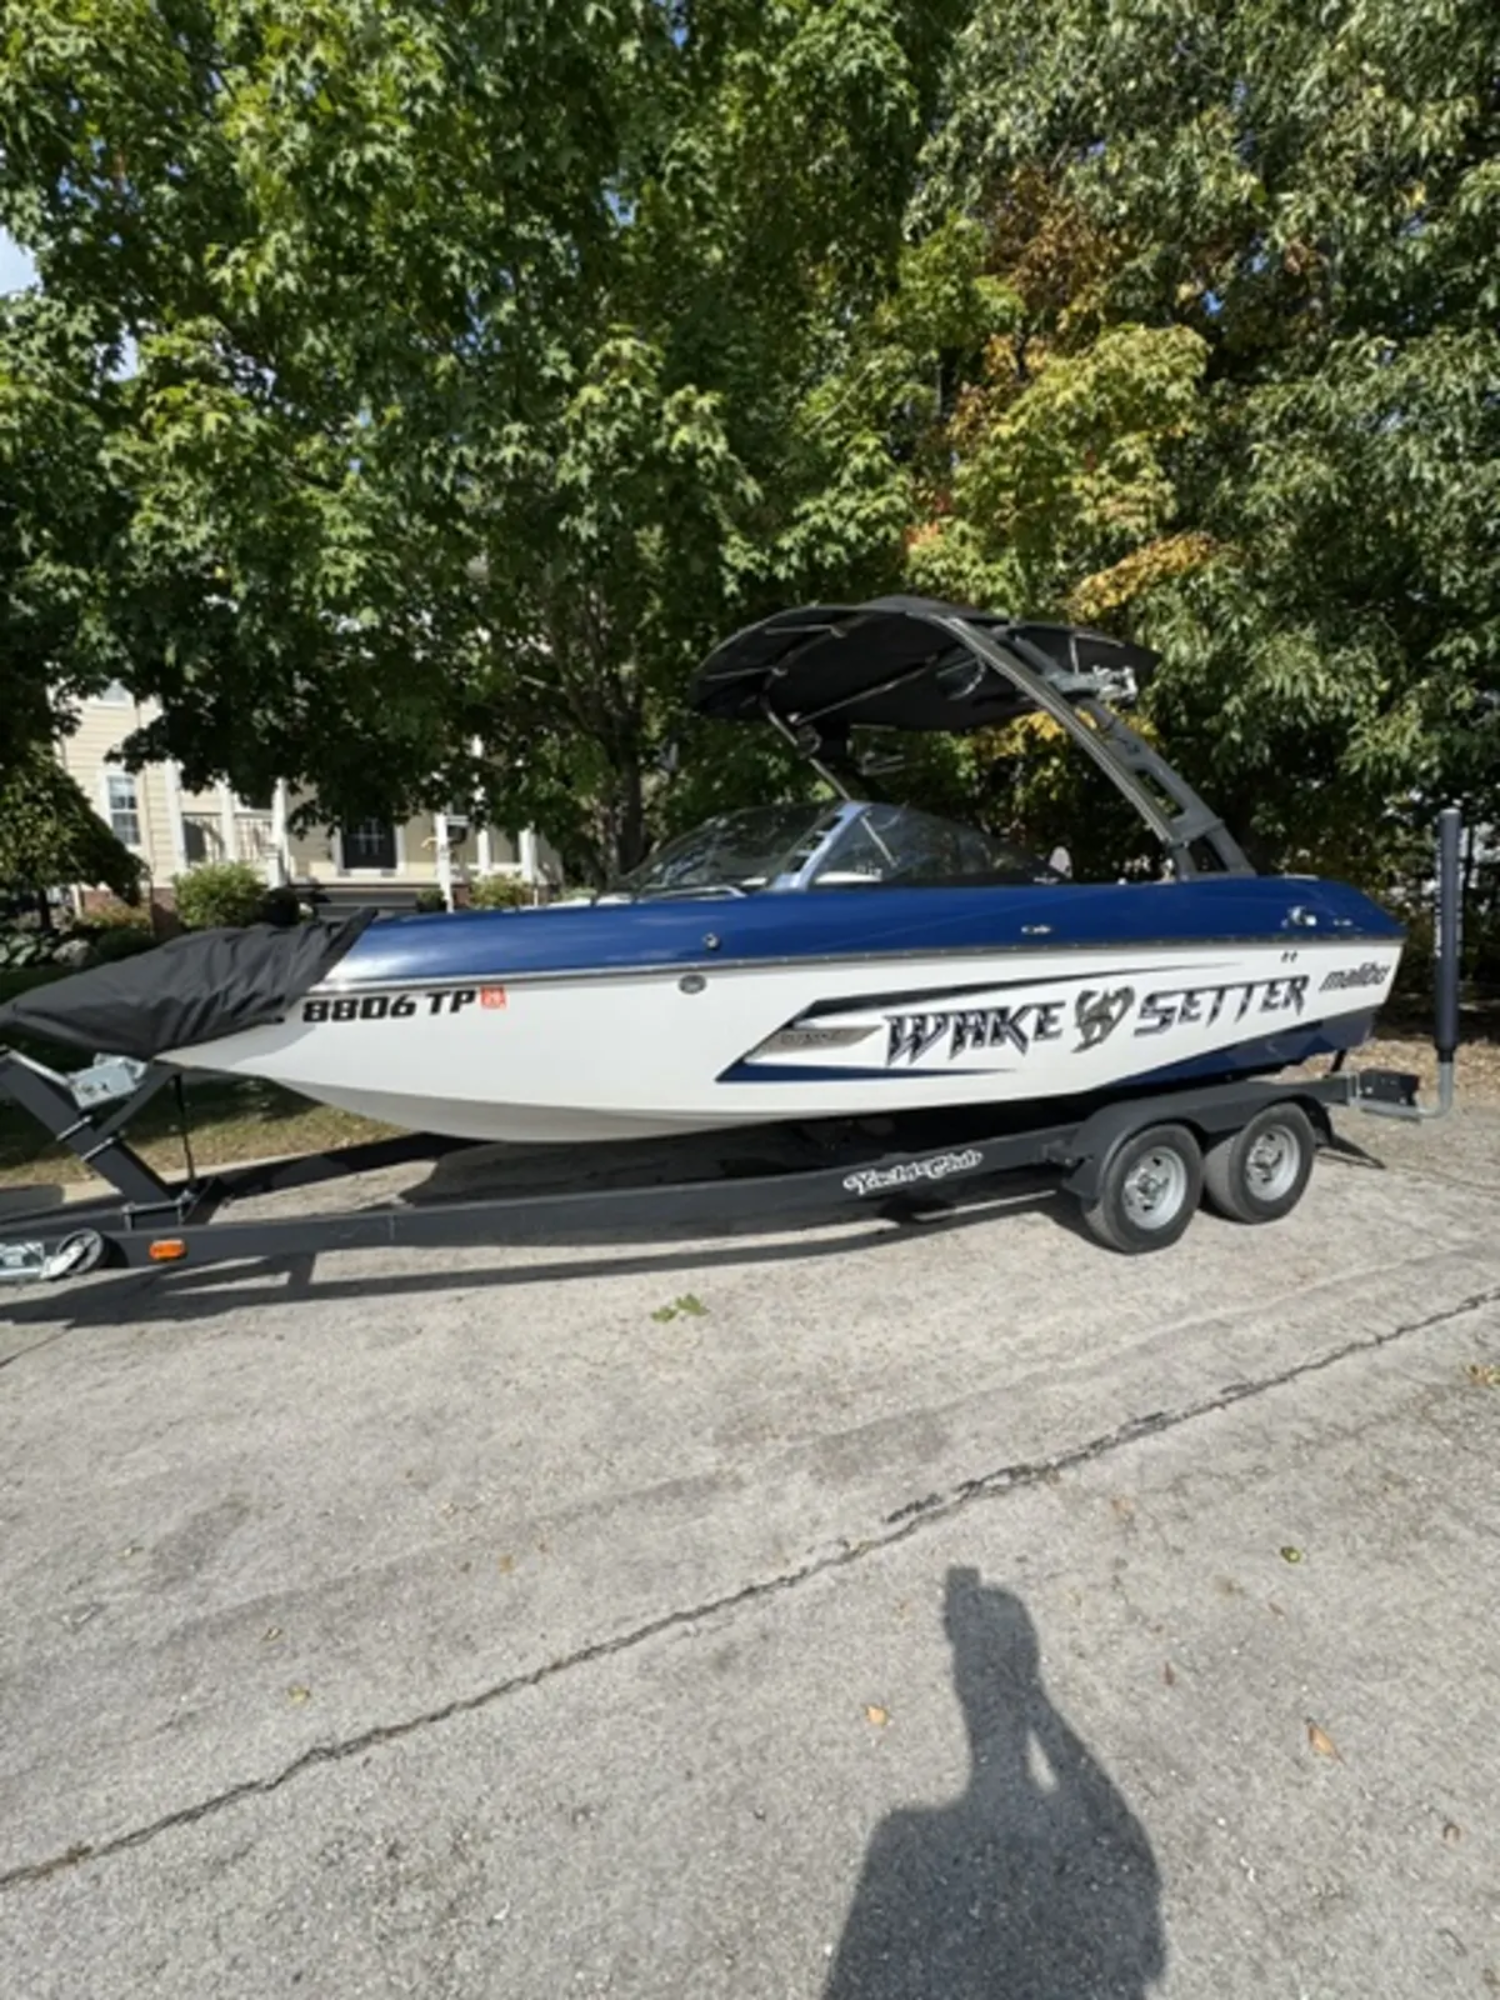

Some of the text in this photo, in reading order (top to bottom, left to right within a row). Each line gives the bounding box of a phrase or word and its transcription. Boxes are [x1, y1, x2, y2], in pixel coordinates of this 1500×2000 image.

[302, 995, 417, 1023] 8806
[425, 988, 476, 1016] TP
[882, 974, 1310, 1067] WAKE SETTER
